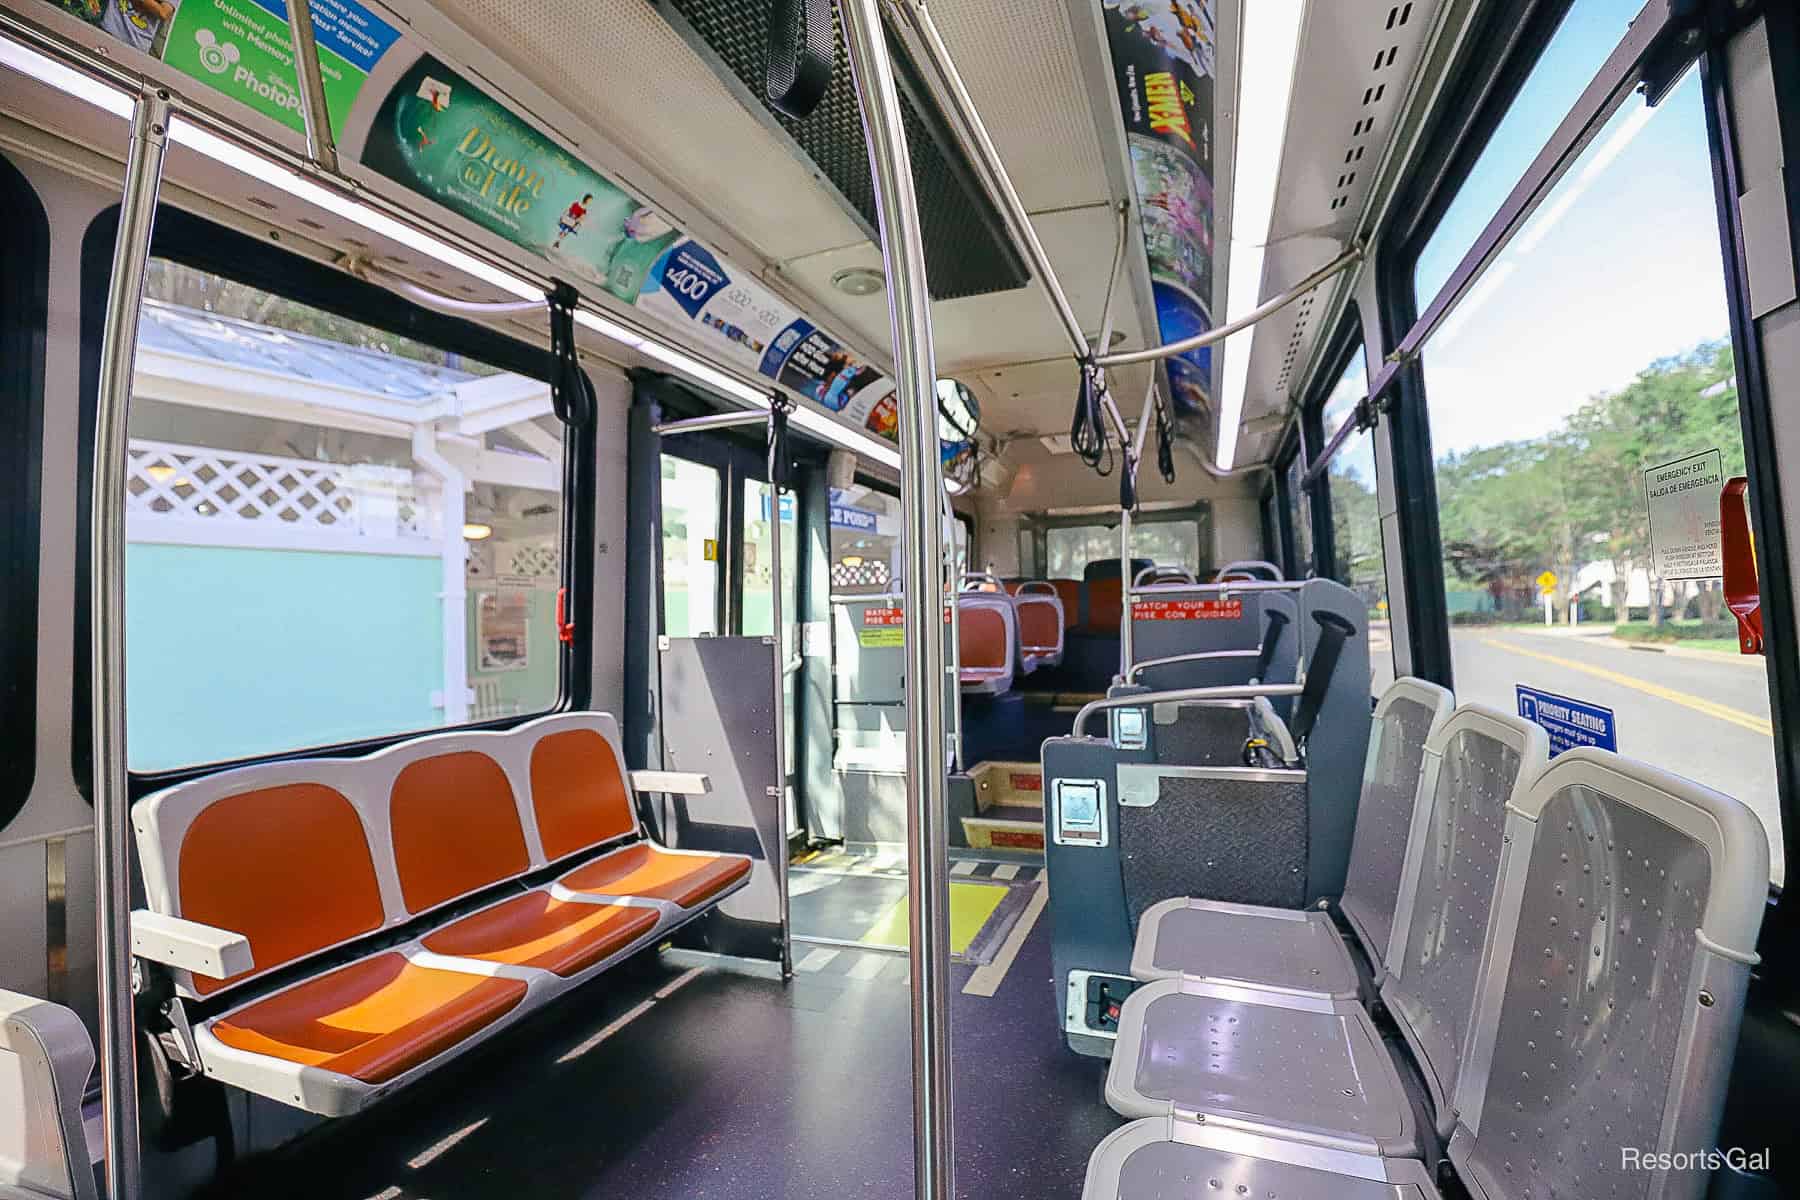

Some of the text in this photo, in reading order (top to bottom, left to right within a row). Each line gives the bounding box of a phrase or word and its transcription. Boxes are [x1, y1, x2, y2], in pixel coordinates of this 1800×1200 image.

[214, 0, 266, 33] Unlimited
[346, 11, 369, 26] your
[223, 19, 291, 65] with Memory
[234, 65, 305, 118] PhotoPa
[1656, 461, 1707, 483] EMERGENCY EXIT
[1649, 473, 1719, 498] SALIDA DE EMERGENCIA
[865, 608, 893, 616] WATCH
[1134, 601, 1240, 610] WATCH YOUR STEP
[1134, 610, 1241, 619] PISE CON CUIDADO
[1571, 711, 1606, 732] SEATING
